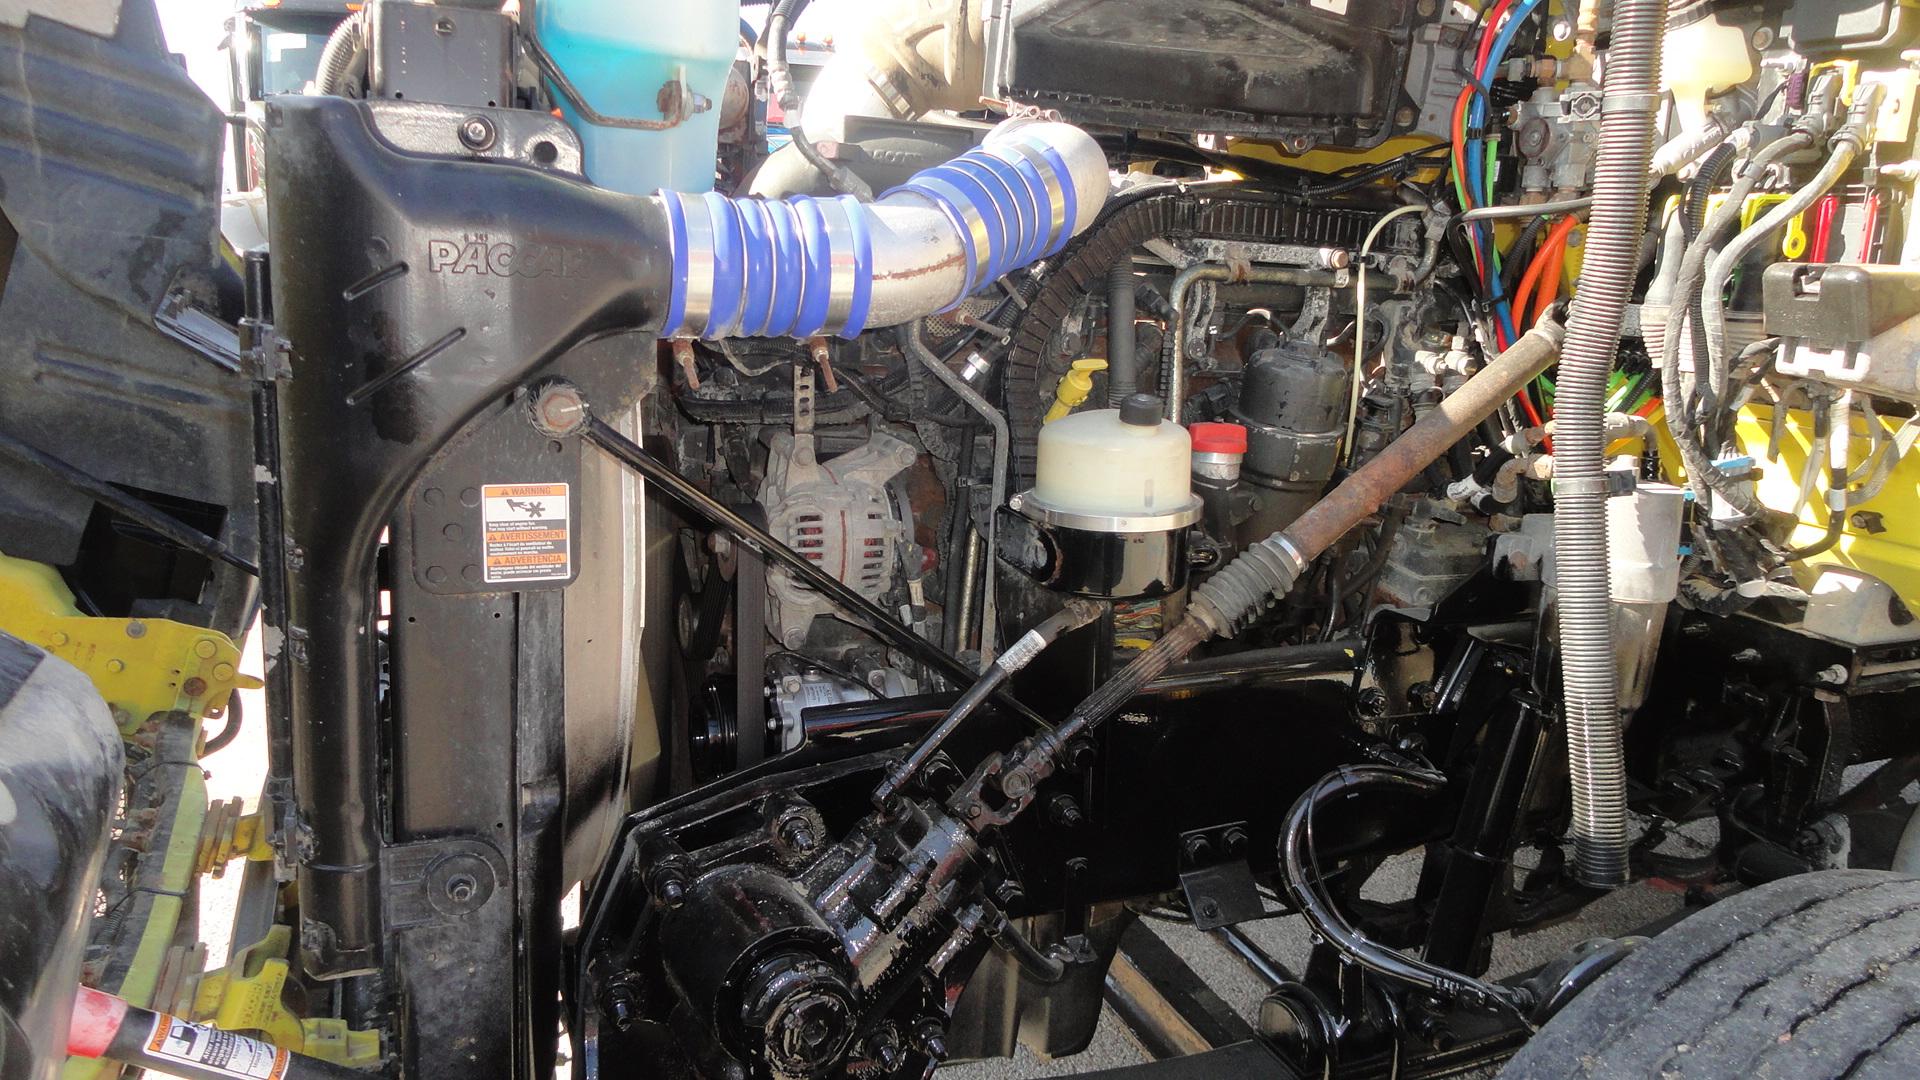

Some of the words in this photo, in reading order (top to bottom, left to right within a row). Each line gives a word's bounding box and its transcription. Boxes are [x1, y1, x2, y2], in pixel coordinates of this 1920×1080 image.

[512, 486, 551, 496] WARNING
[500, 530, 564, 540] AVERTISSEMENT
[505, 554, 562, 565] ADVERTENCIA
